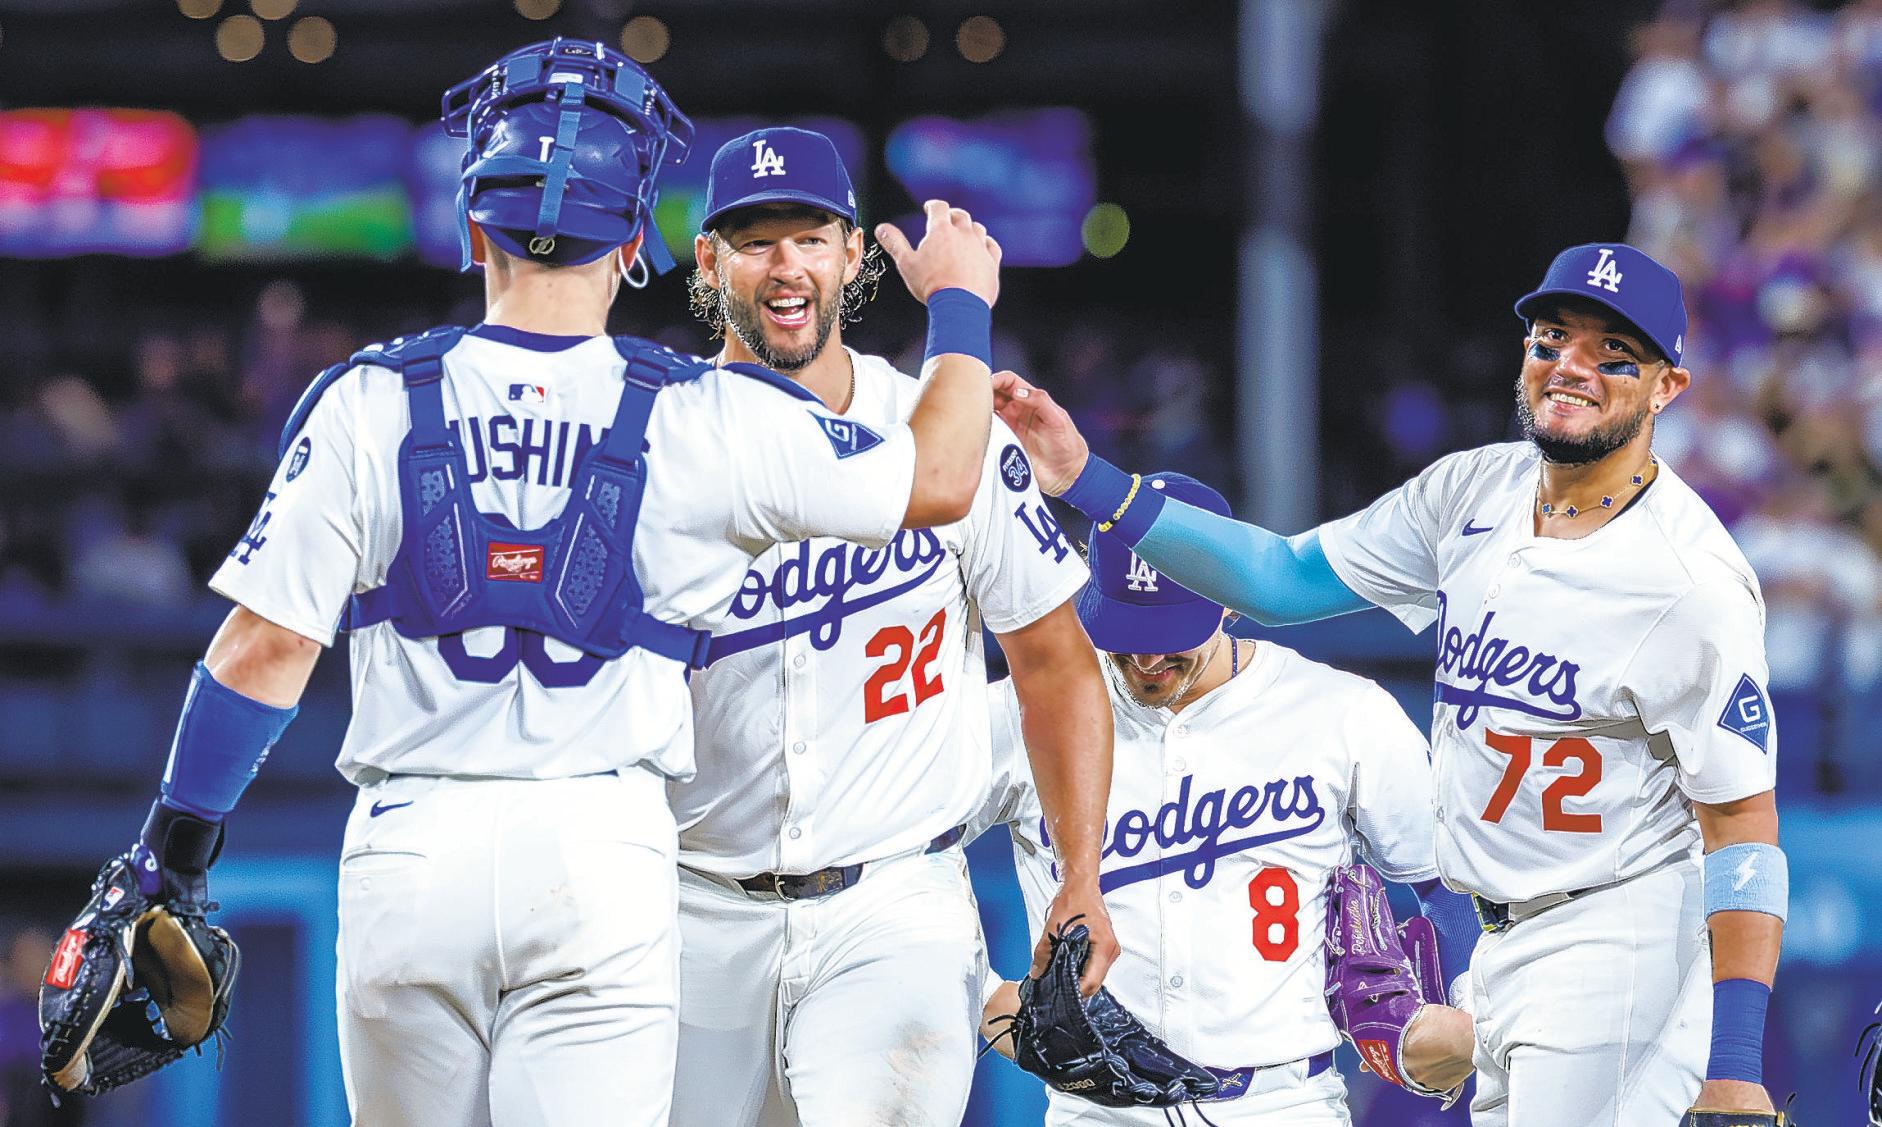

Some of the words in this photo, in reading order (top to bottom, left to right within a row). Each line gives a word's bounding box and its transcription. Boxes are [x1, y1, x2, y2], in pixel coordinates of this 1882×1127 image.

[751, 139, 786, 179] LA
[1586, 248, 1623, 293] LA
[449, 415, 651, 489] USHIN
[725, 527, 946, 651] odgers
[1126, 551, 1159, 592] LA
[863, 607, 947, 724] 22
[1738, 694, 1761, 723] G
[1480, 726, 1603, 833] 72
[1040, 774, 1325, 889] odgers
[1248, 867, 1300, 962] 8
